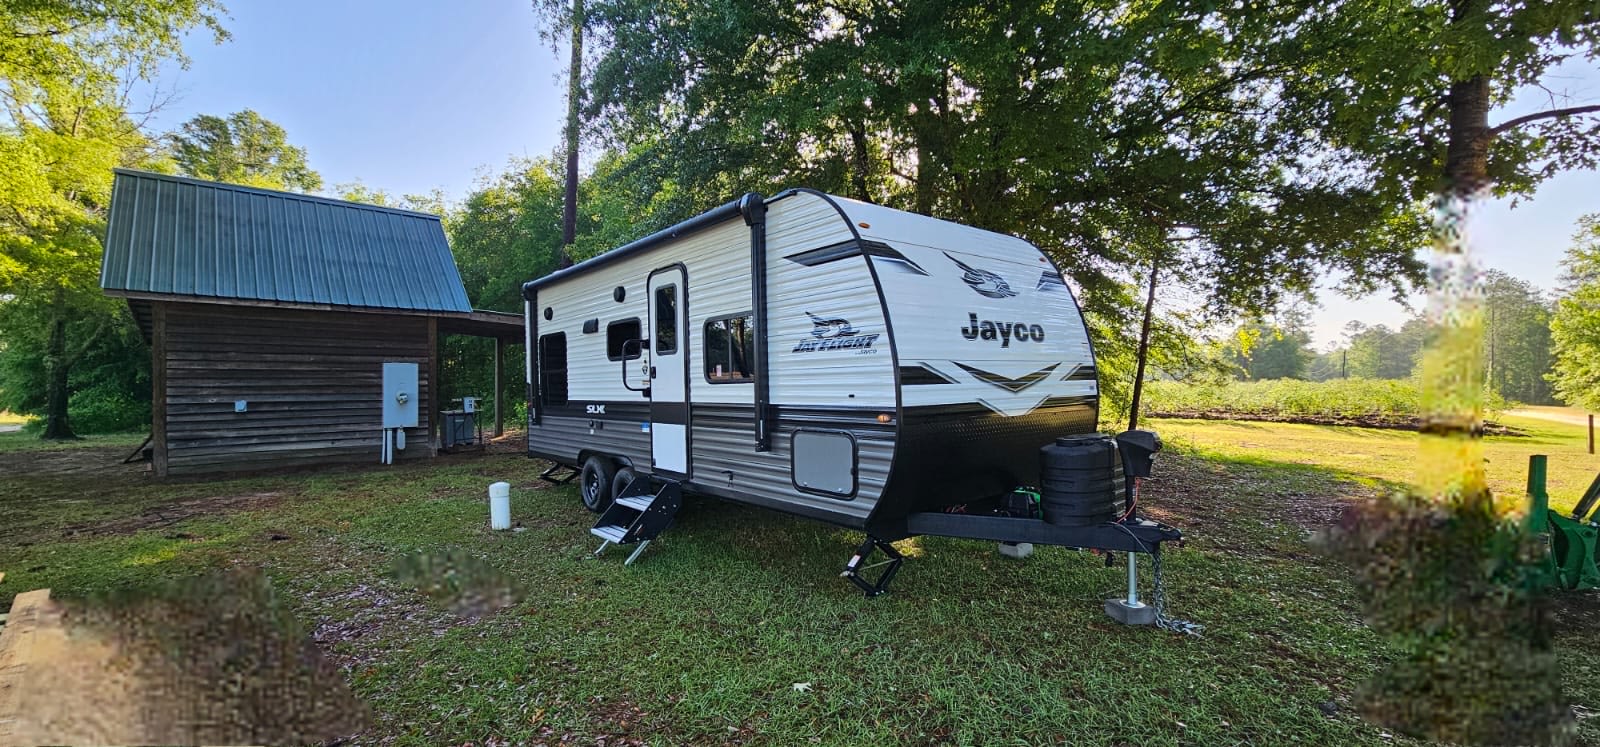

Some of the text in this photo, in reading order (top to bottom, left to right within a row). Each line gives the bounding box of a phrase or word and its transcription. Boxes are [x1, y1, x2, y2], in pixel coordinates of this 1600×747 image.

[961, 312, 1045, 349] Jayco
[792, 334, 880, 353] JAY FLIGHT
[586, 404, 606, 414] SLX
